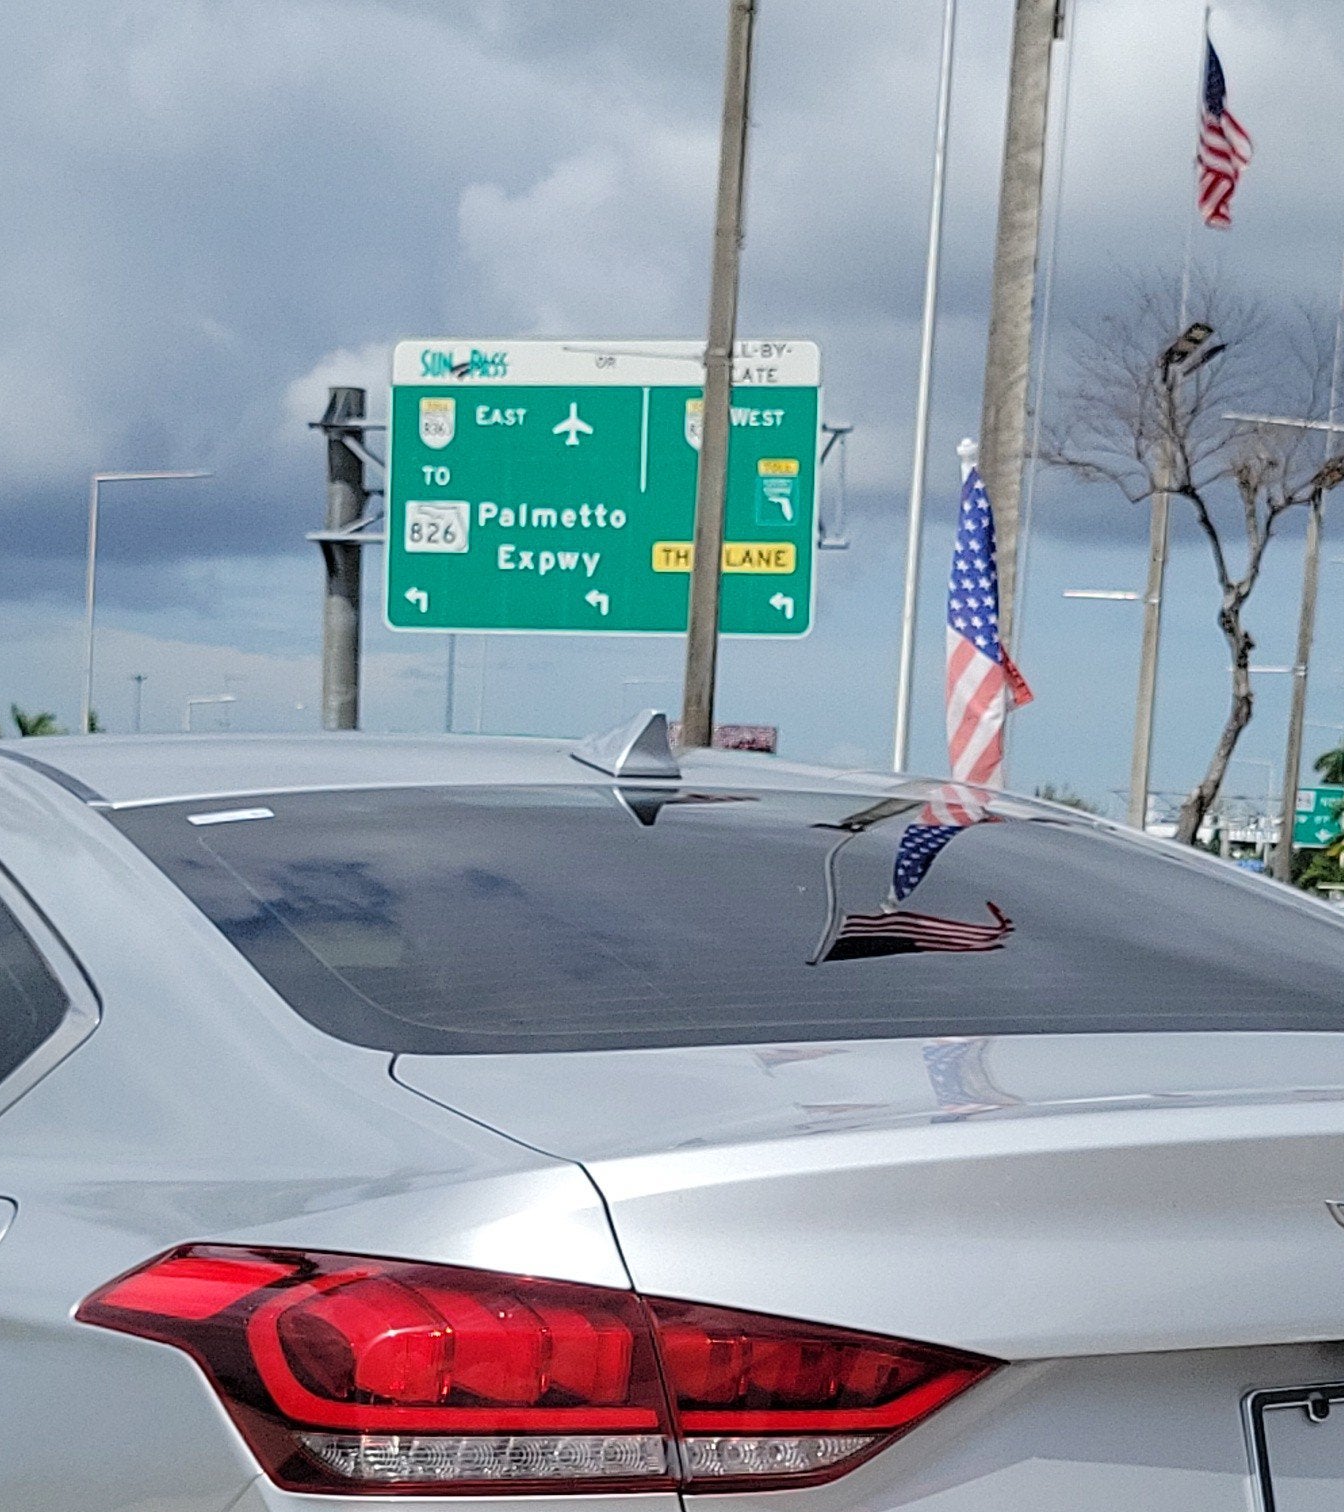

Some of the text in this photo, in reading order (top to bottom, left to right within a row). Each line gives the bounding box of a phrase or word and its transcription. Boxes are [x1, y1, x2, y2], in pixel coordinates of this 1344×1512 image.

[475, 404, 527, 426] EAST
[730, 406, 786, 427] WEST
[421, 465, 452, 486] TO
[478, 501, 628, 529] Palmetto
[409, 522, 456, 544] 826
[497, 543, 601, 578] Expwy
[725, 549, 787, 568] LANE
